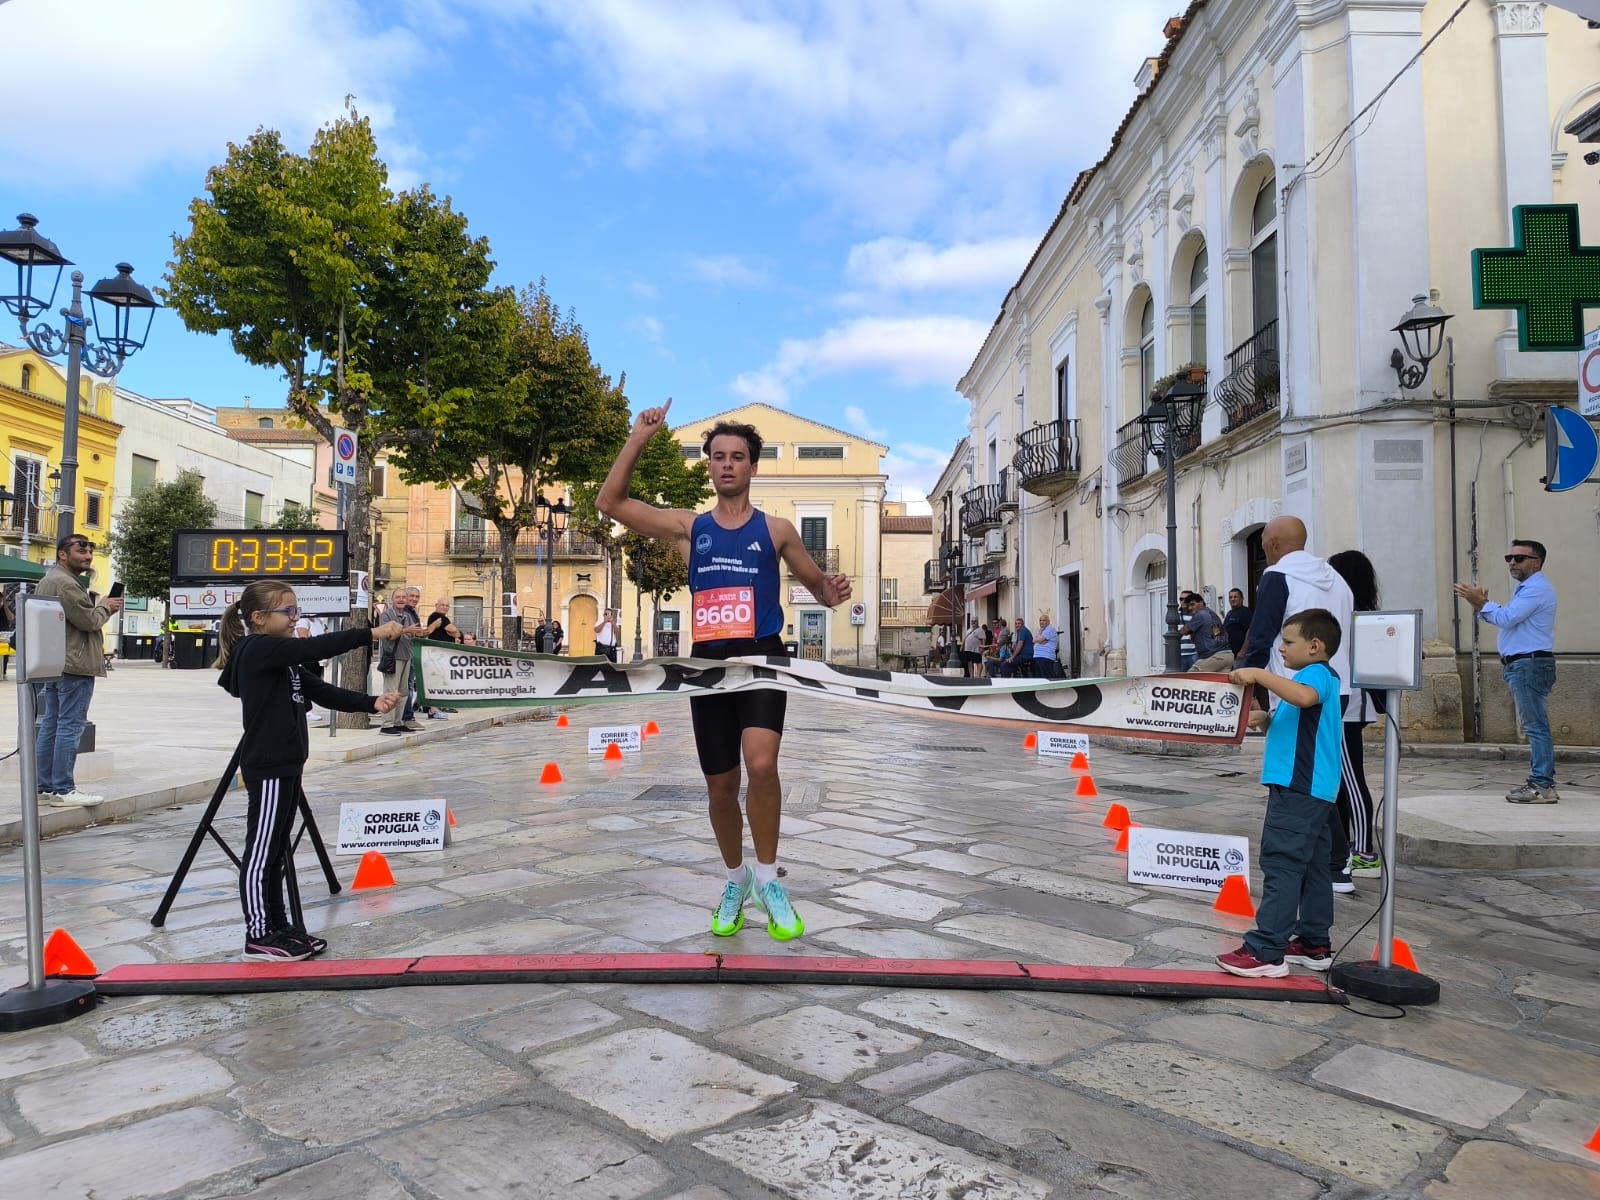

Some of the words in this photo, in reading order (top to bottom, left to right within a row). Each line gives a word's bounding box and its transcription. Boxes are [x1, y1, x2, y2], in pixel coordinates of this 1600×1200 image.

[212, 538, 333, 571] 0:33:52
[695, 603, 751, 627] 9660
[449, 655, 512, 667] CORRERE
[450, 669, 464, 680] IN
[466, 669, 513, 680] PUGLIA
[427, 685, 537, 696] www.correreinpuglia.it
[1151, 686, 1216, 703] CORRERE
[1151, 699, 1165, 711] IN
[1166, 701, 1213, 716] PUGLIA
[1126, 717, 1236, 734] www.correreinpuglia.it
[364, 812, 421, 824] CORRERE
[364, 825, 376, 835] IN
[377, 823, 420, 834] PUGLIA
[341, 837, 440, 849] www.correreinpuglia.it
[1156, 842, 1221, 859] CORRERE
[1156, 855, 1170, 866] IN
[1172, 856, 1221, 872] PUGLIA
